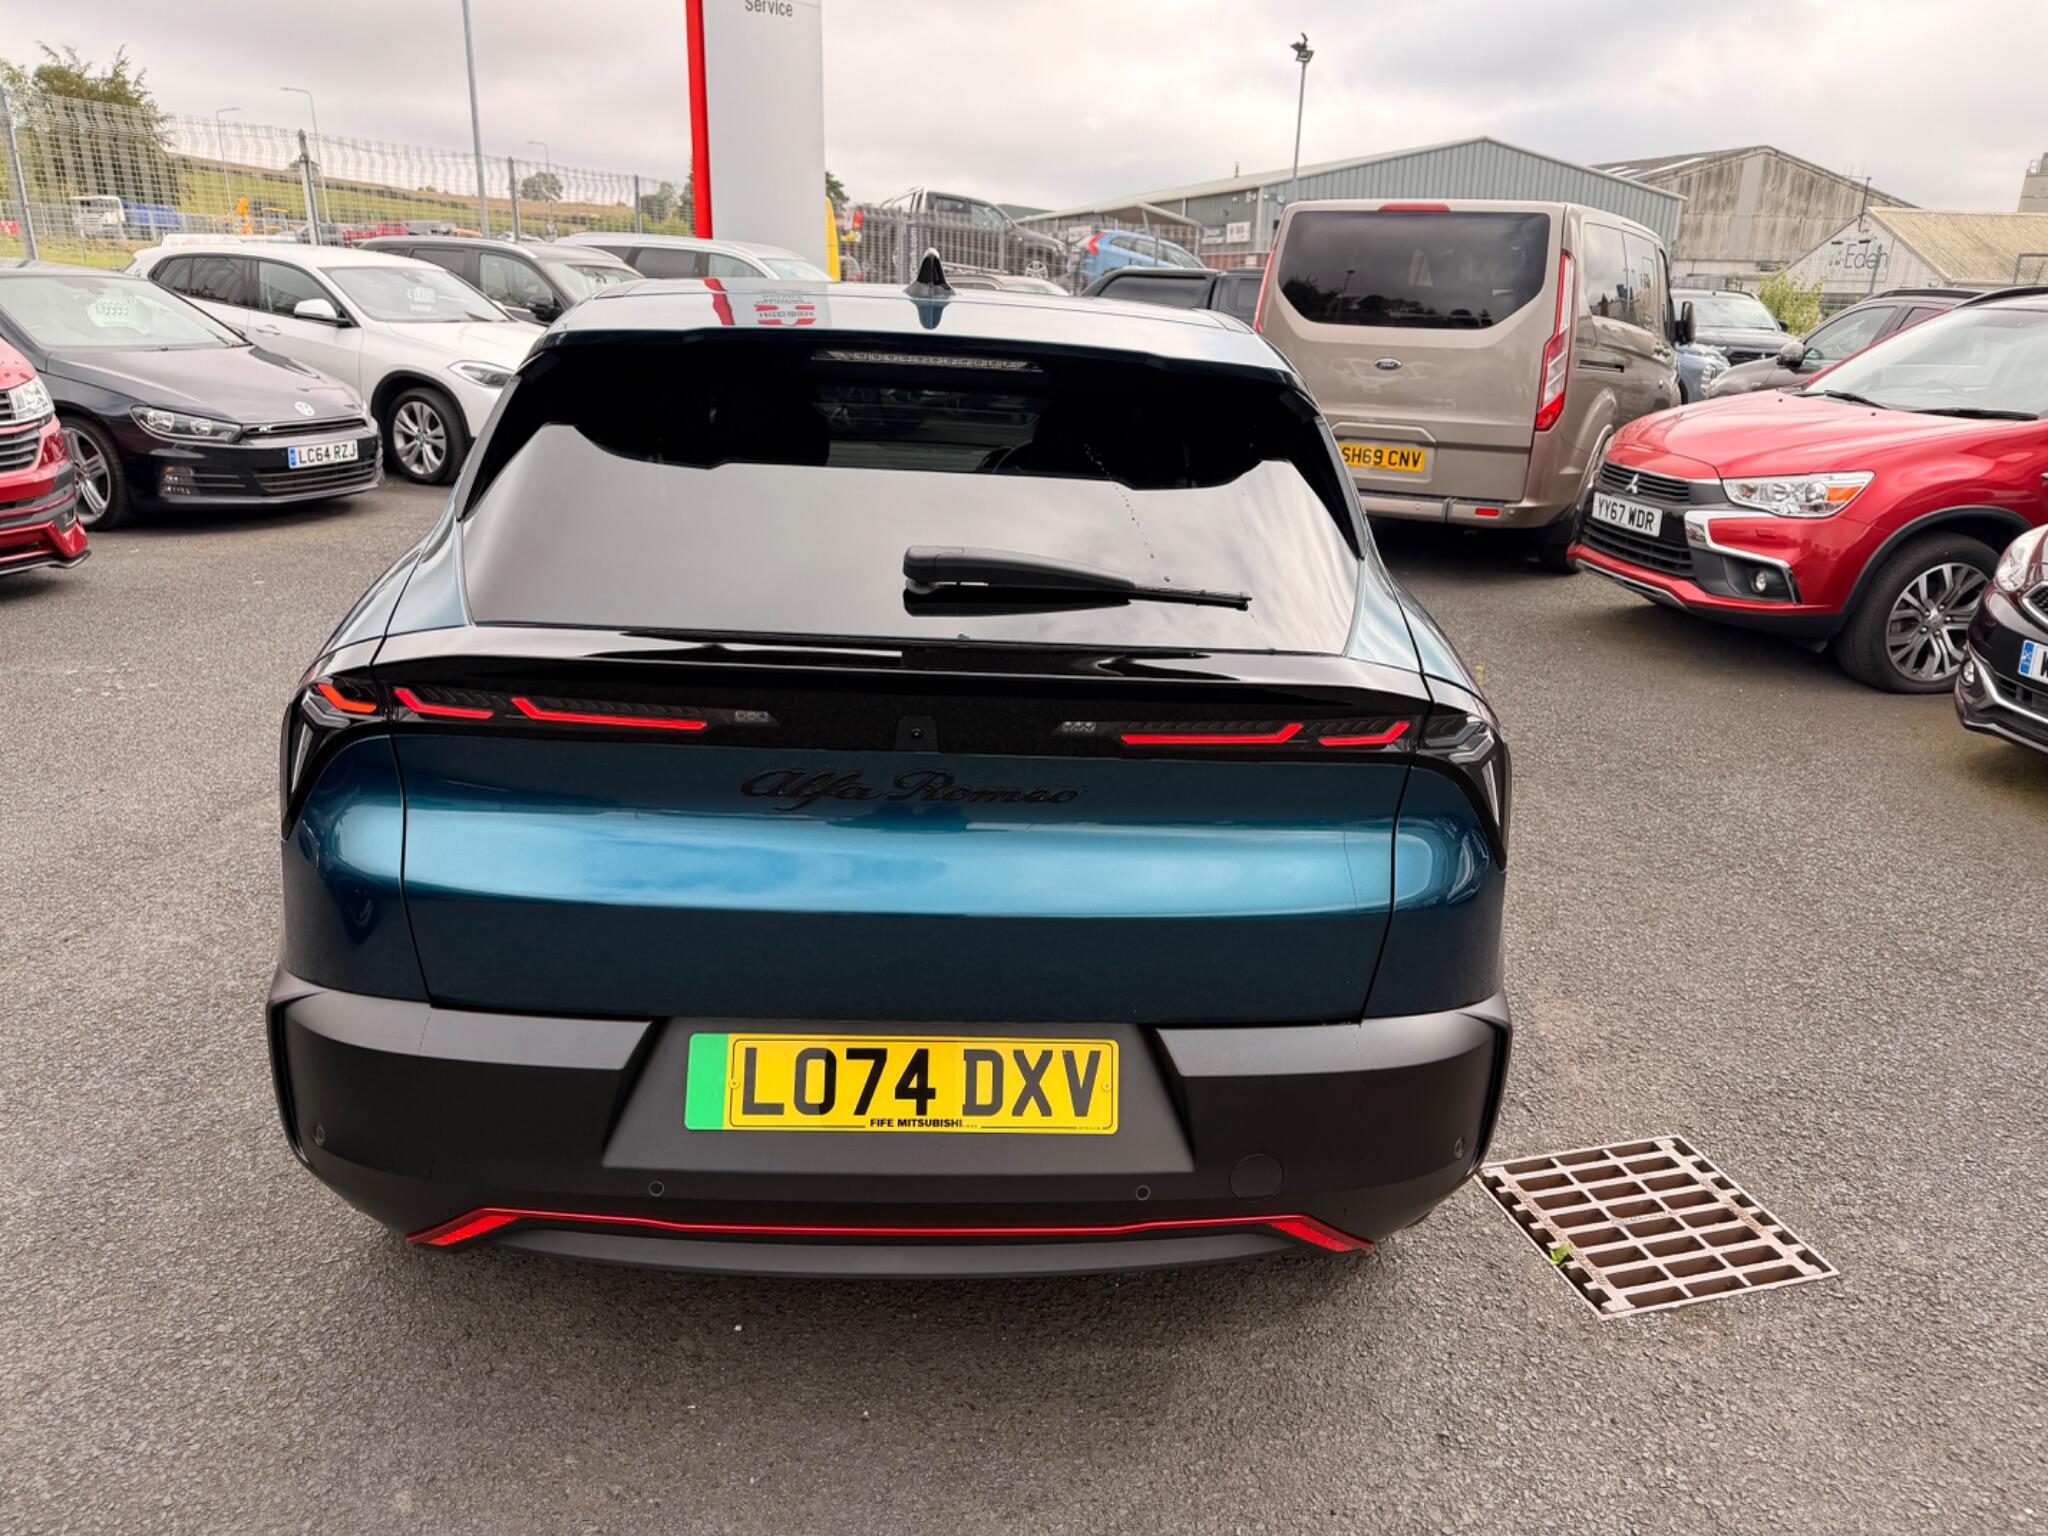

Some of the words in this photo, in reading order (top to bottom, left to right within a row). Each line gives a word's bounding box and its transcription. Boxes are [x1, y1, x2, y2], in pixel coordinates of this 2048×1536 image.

[745, 0, 793, 17] Service
[1844, 243, 1889, 269] Eden
[298, 446, 331, 464] LC64
[333, 442, 357, 459] RZJ
[1341, 446, 1383, 465] SH69
[1387, 449, 1422, 468] CNV
[1598, 496, 1626, 523] YY67
[1627, 506, 1655, 532] WDR
[740, 767, 882, 811] Alfa
[885, 767, 1085, 804] Romeo
[741, 1046, 937, 1117] LO74
[961, 1049, 1102, 1118] DXV
[870, 1118, 894, 1128] FIFE
[897, 1118, 963, 1129] MITSUBISHI
